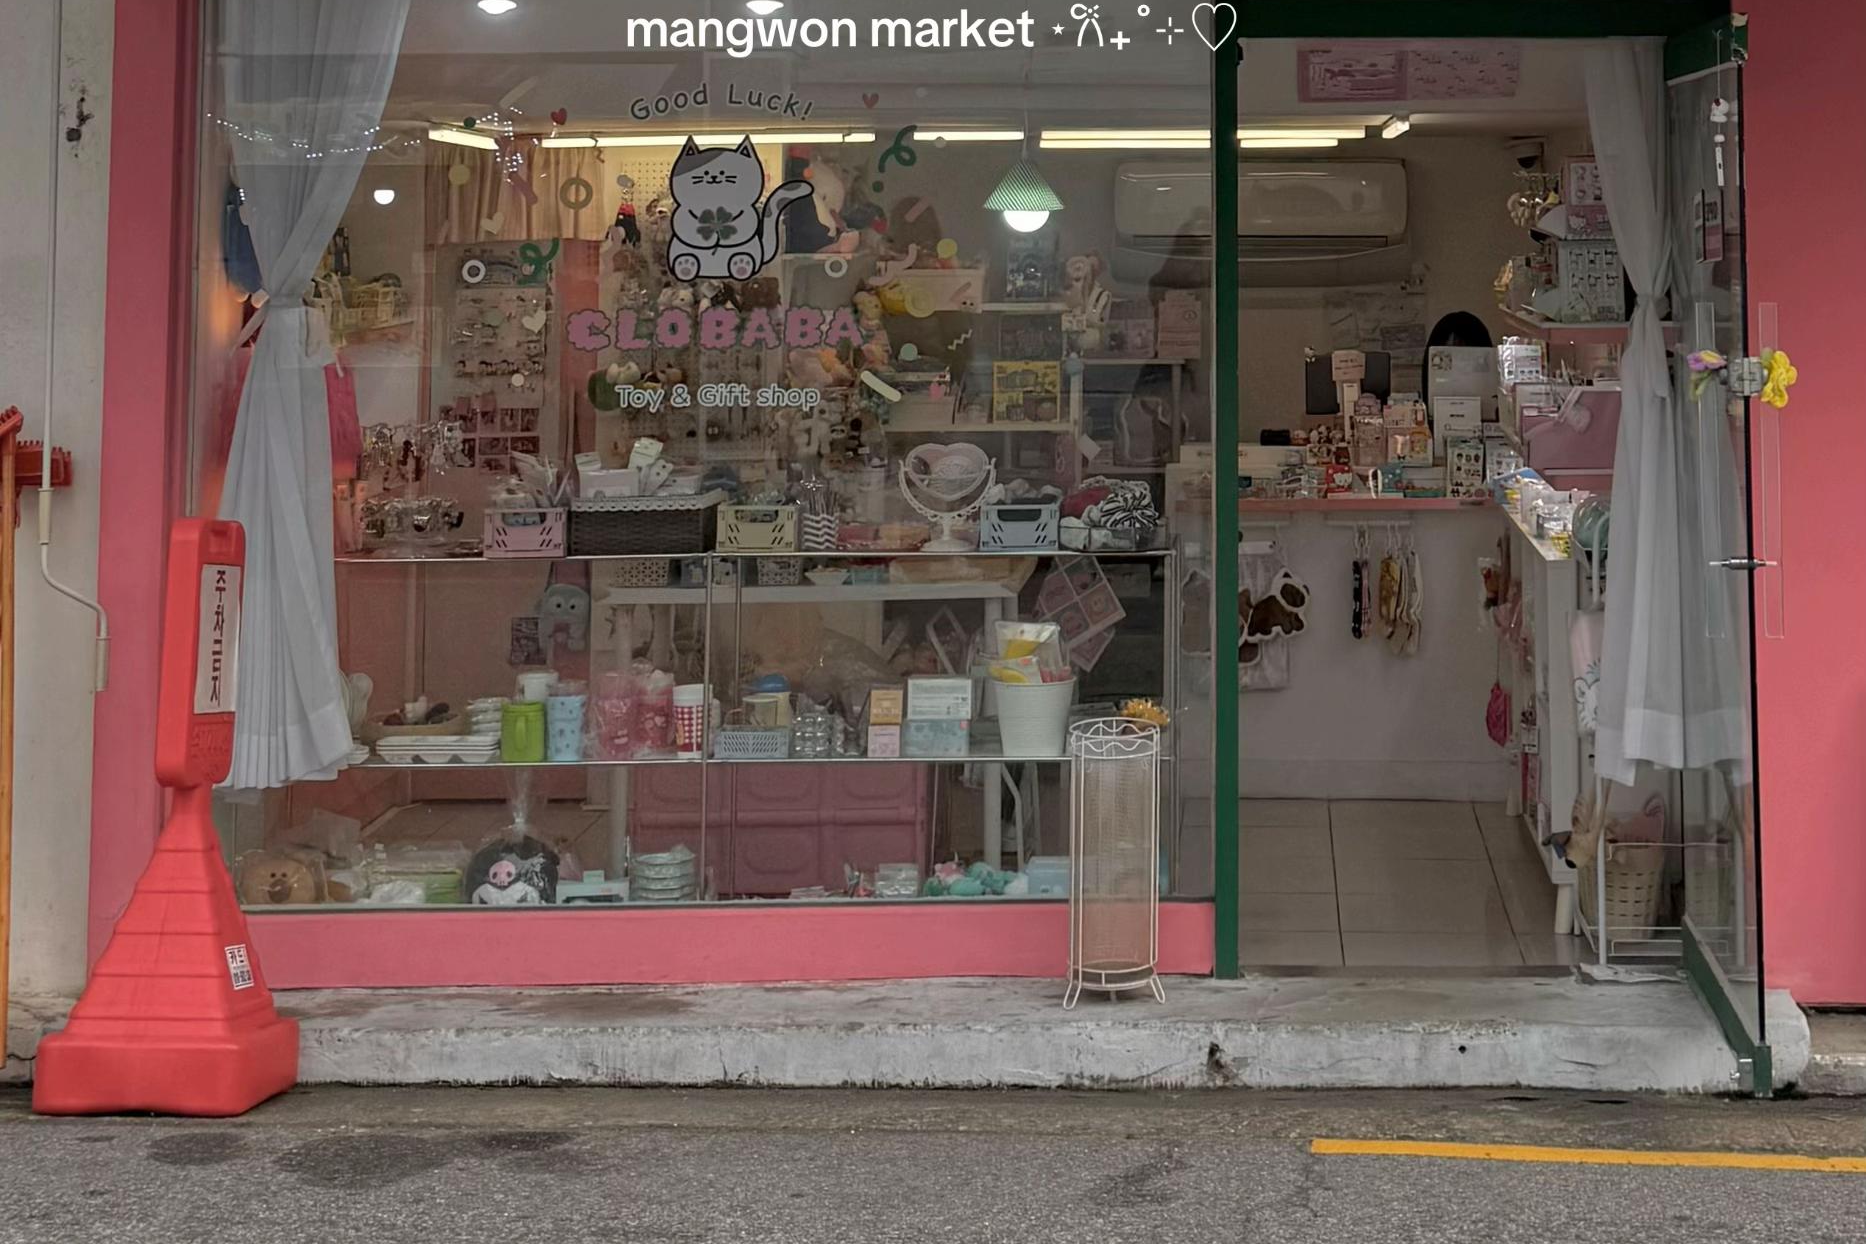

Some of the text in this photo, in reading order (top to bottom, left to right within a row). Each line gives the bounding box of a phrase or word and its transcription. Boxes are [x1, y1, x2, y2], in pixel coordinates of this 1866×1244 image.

[630, 82, 813, 121] Good Luck!
[565, 306, 864, 351] CLOBABA
[616, 384, 821, 412] Toy & Gift shop
[210, 569, 227, 707] 주차금지
